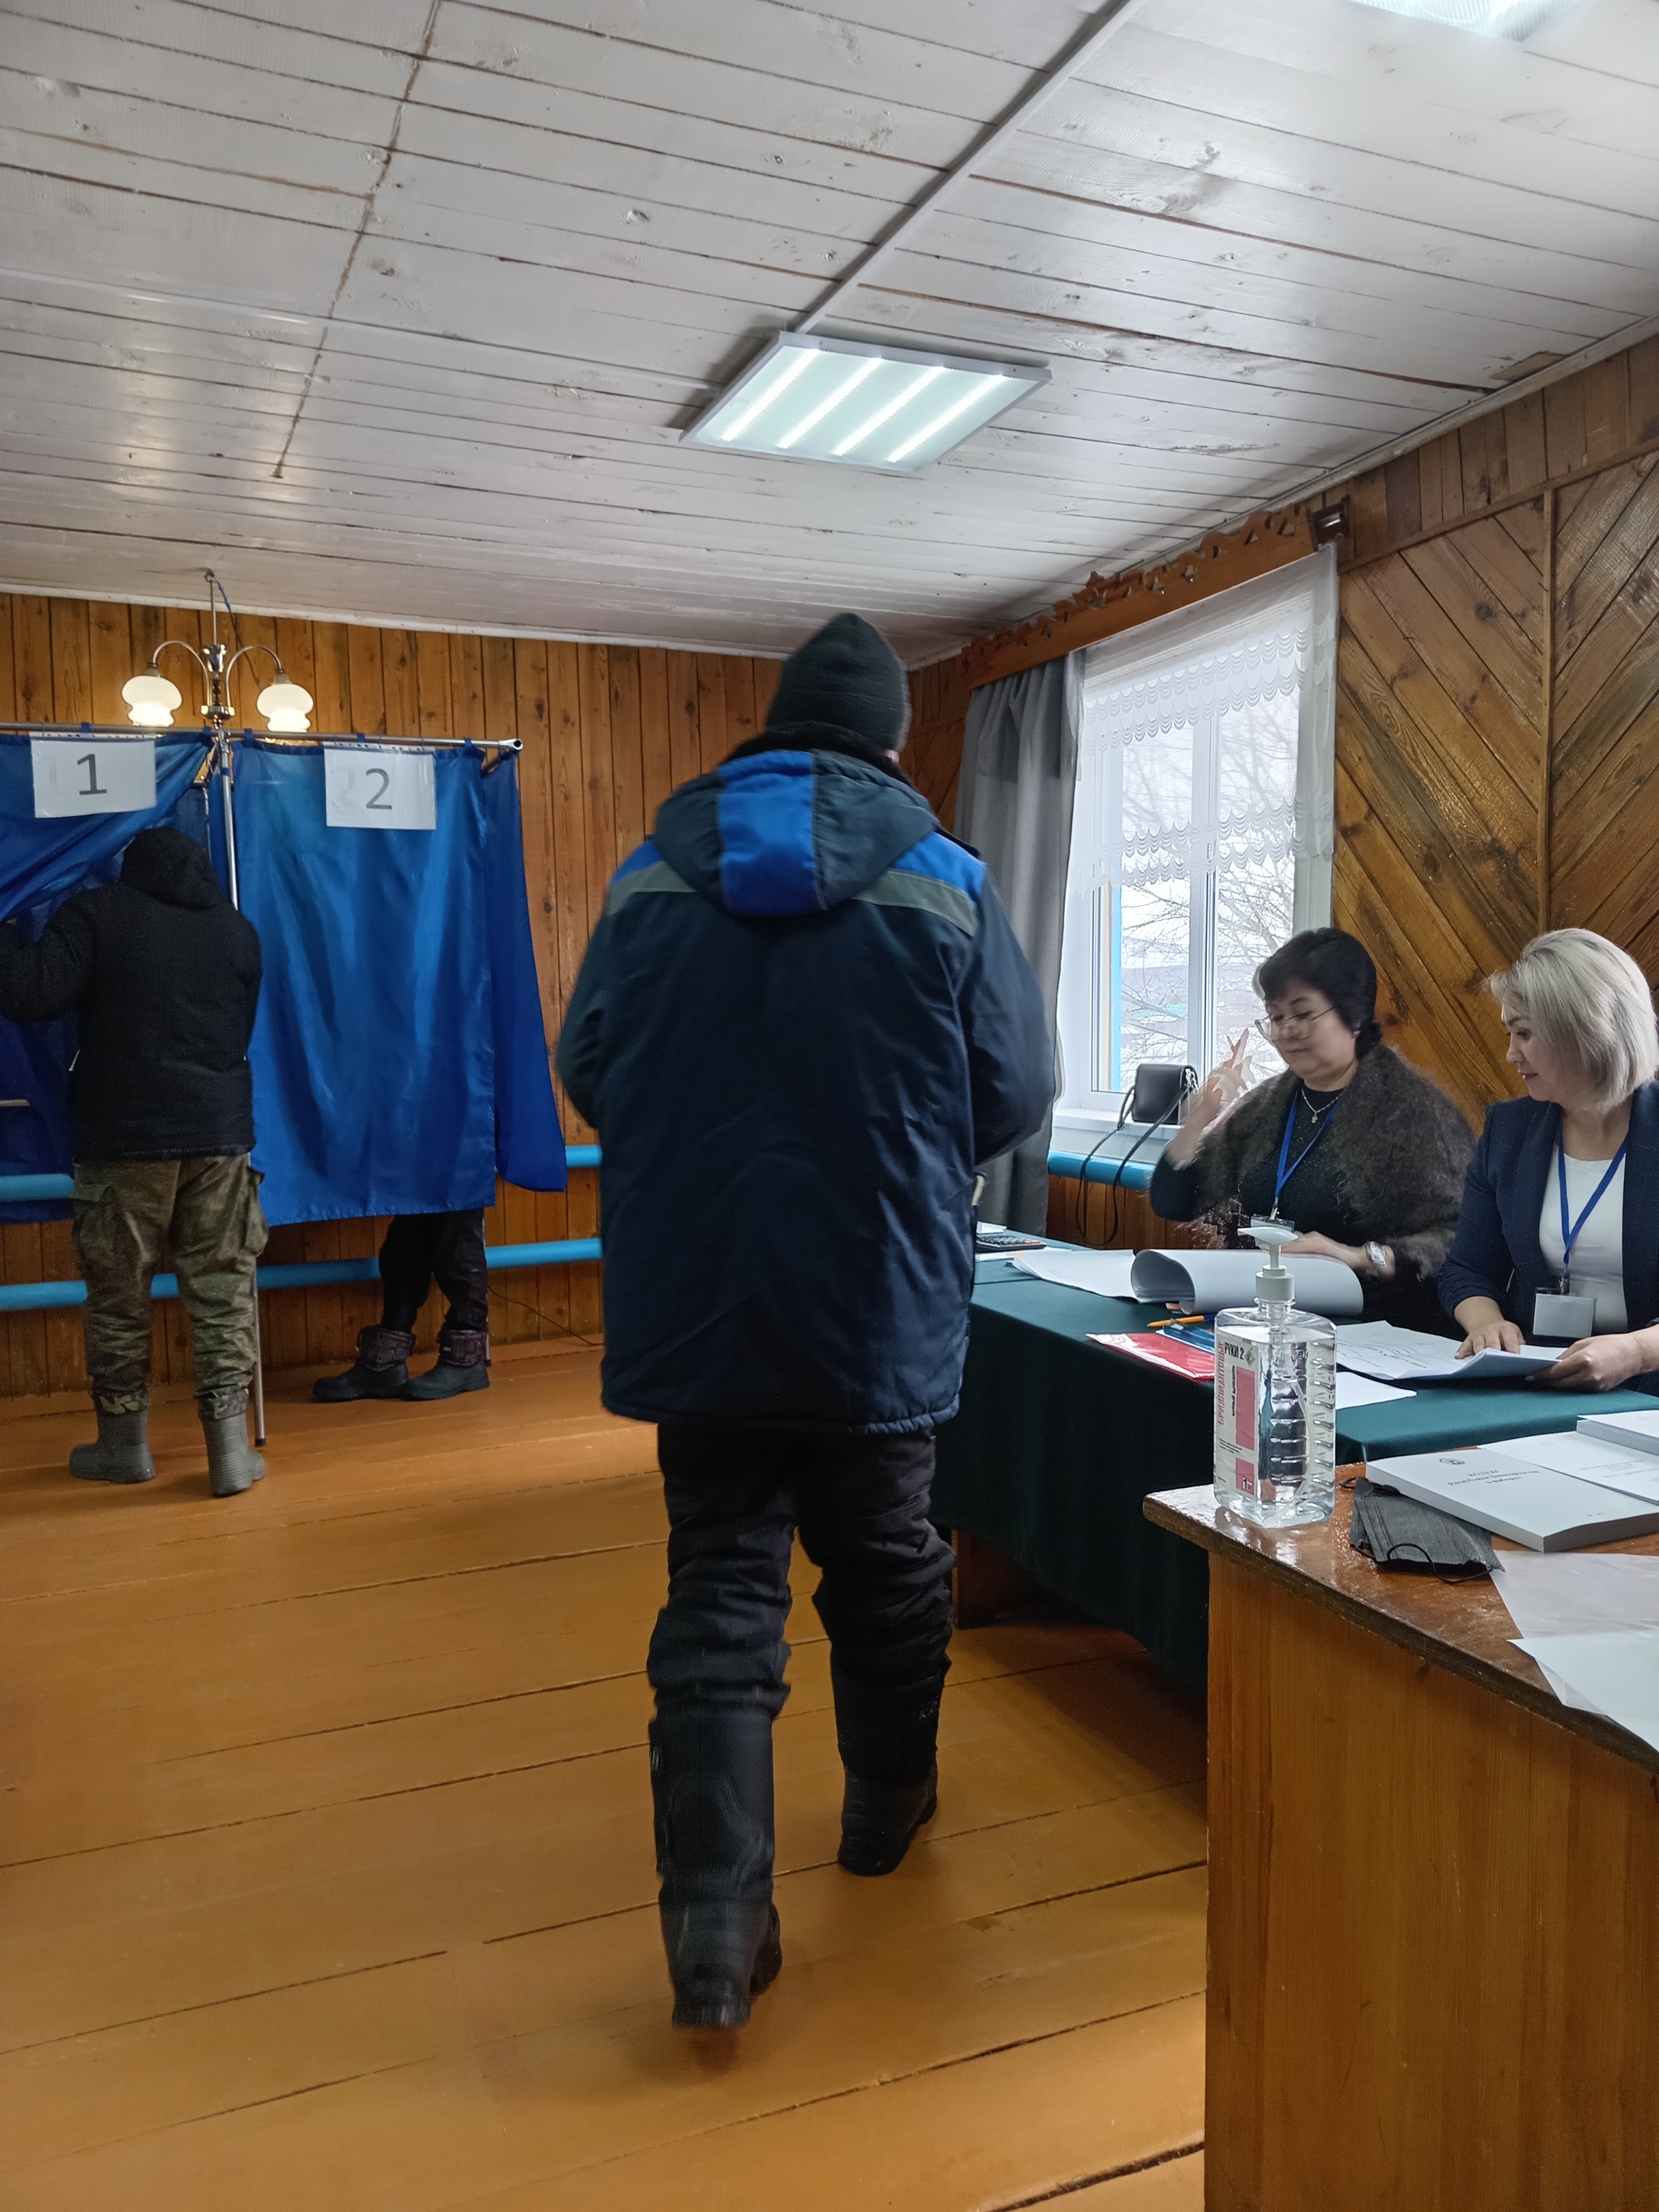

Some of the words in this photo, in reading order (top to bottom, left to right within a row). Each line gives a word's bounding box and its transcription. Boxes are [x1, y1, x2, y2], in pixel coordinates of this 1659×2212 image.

[77, 753, 107, 796] 1
[365, 767, 393, 810] 2
[1224, 1341, 1239, 1359] РУКИ
[1239, 1347, 1244, 1360] 2
